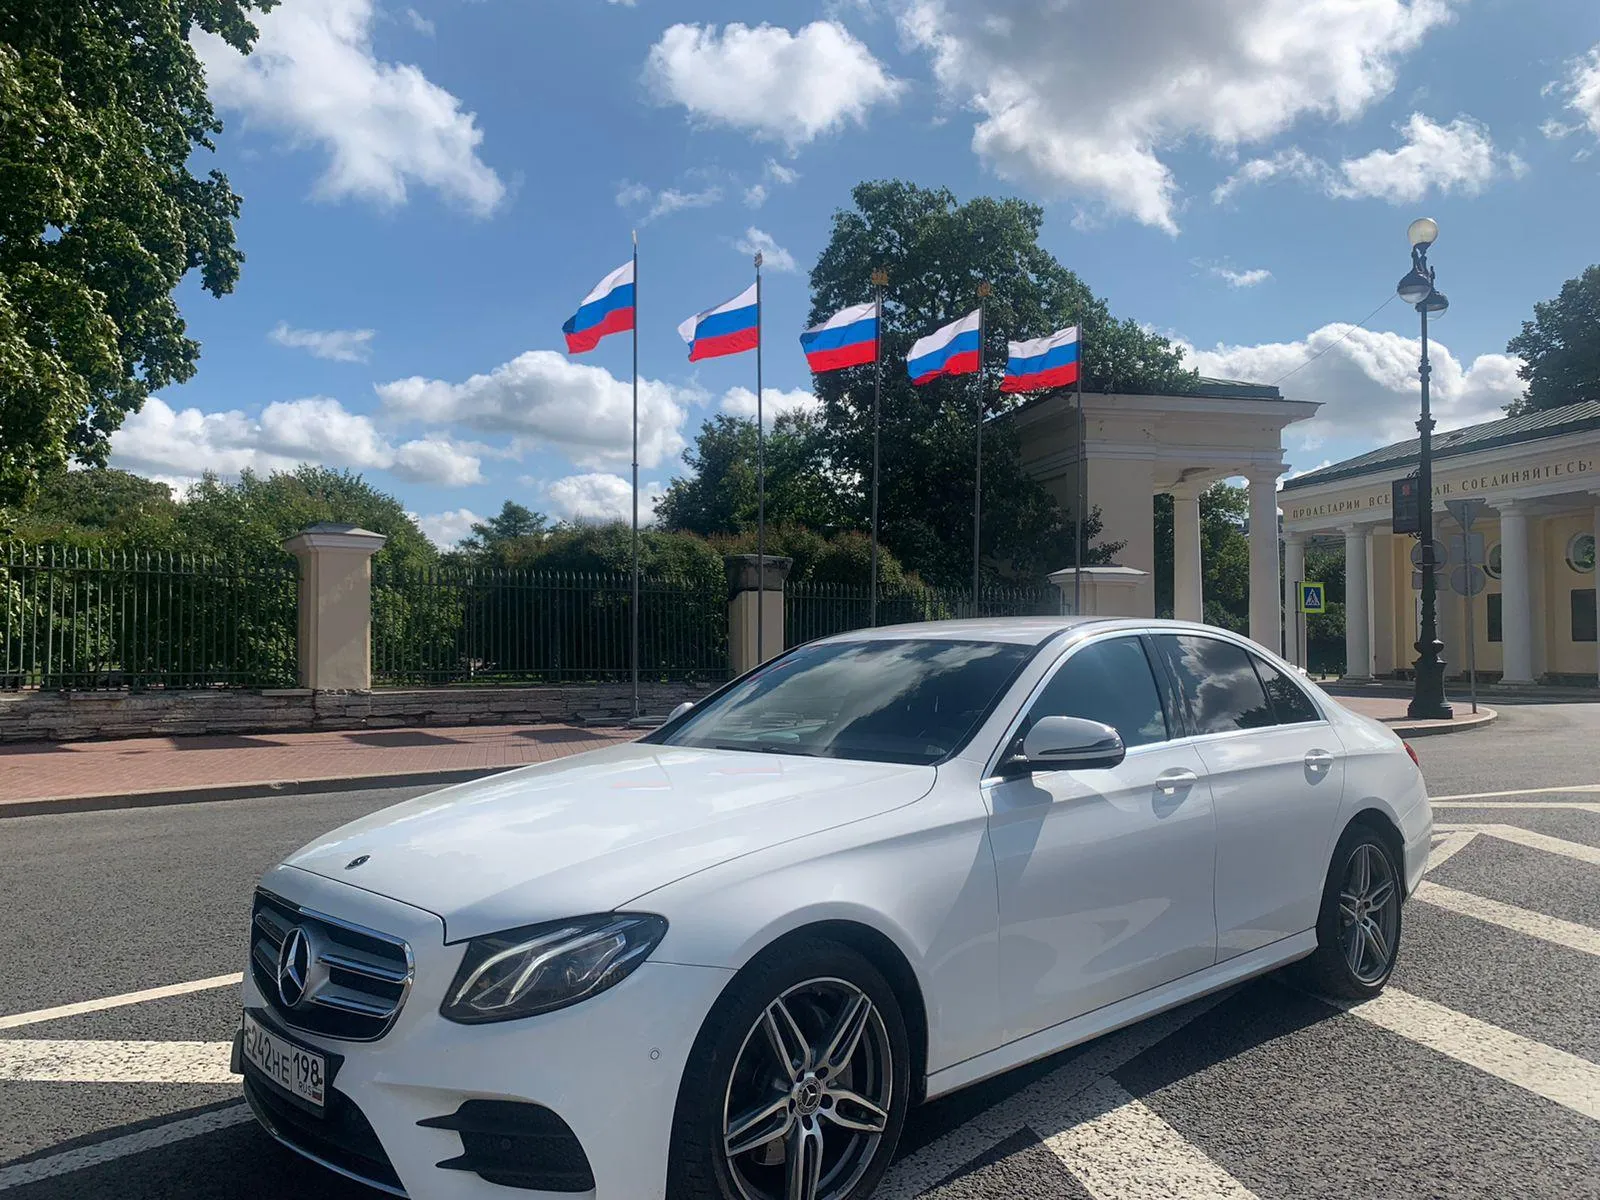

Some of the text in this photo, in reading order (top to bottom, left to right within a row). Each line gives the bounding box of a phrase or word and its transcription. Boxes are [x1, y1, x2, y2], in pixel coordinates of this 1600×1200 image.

[1292, 499, 1360, 519] ПРОЛЕТАРИИ
[1368, 494, 1391, 507] ВСЕ
[1461, 460, 1593, 491] СОЕДИНЯЙТЕСЬ!
[293, 1052, 319, 1087] 198
[298, 1081, 312, 1096] RUS
